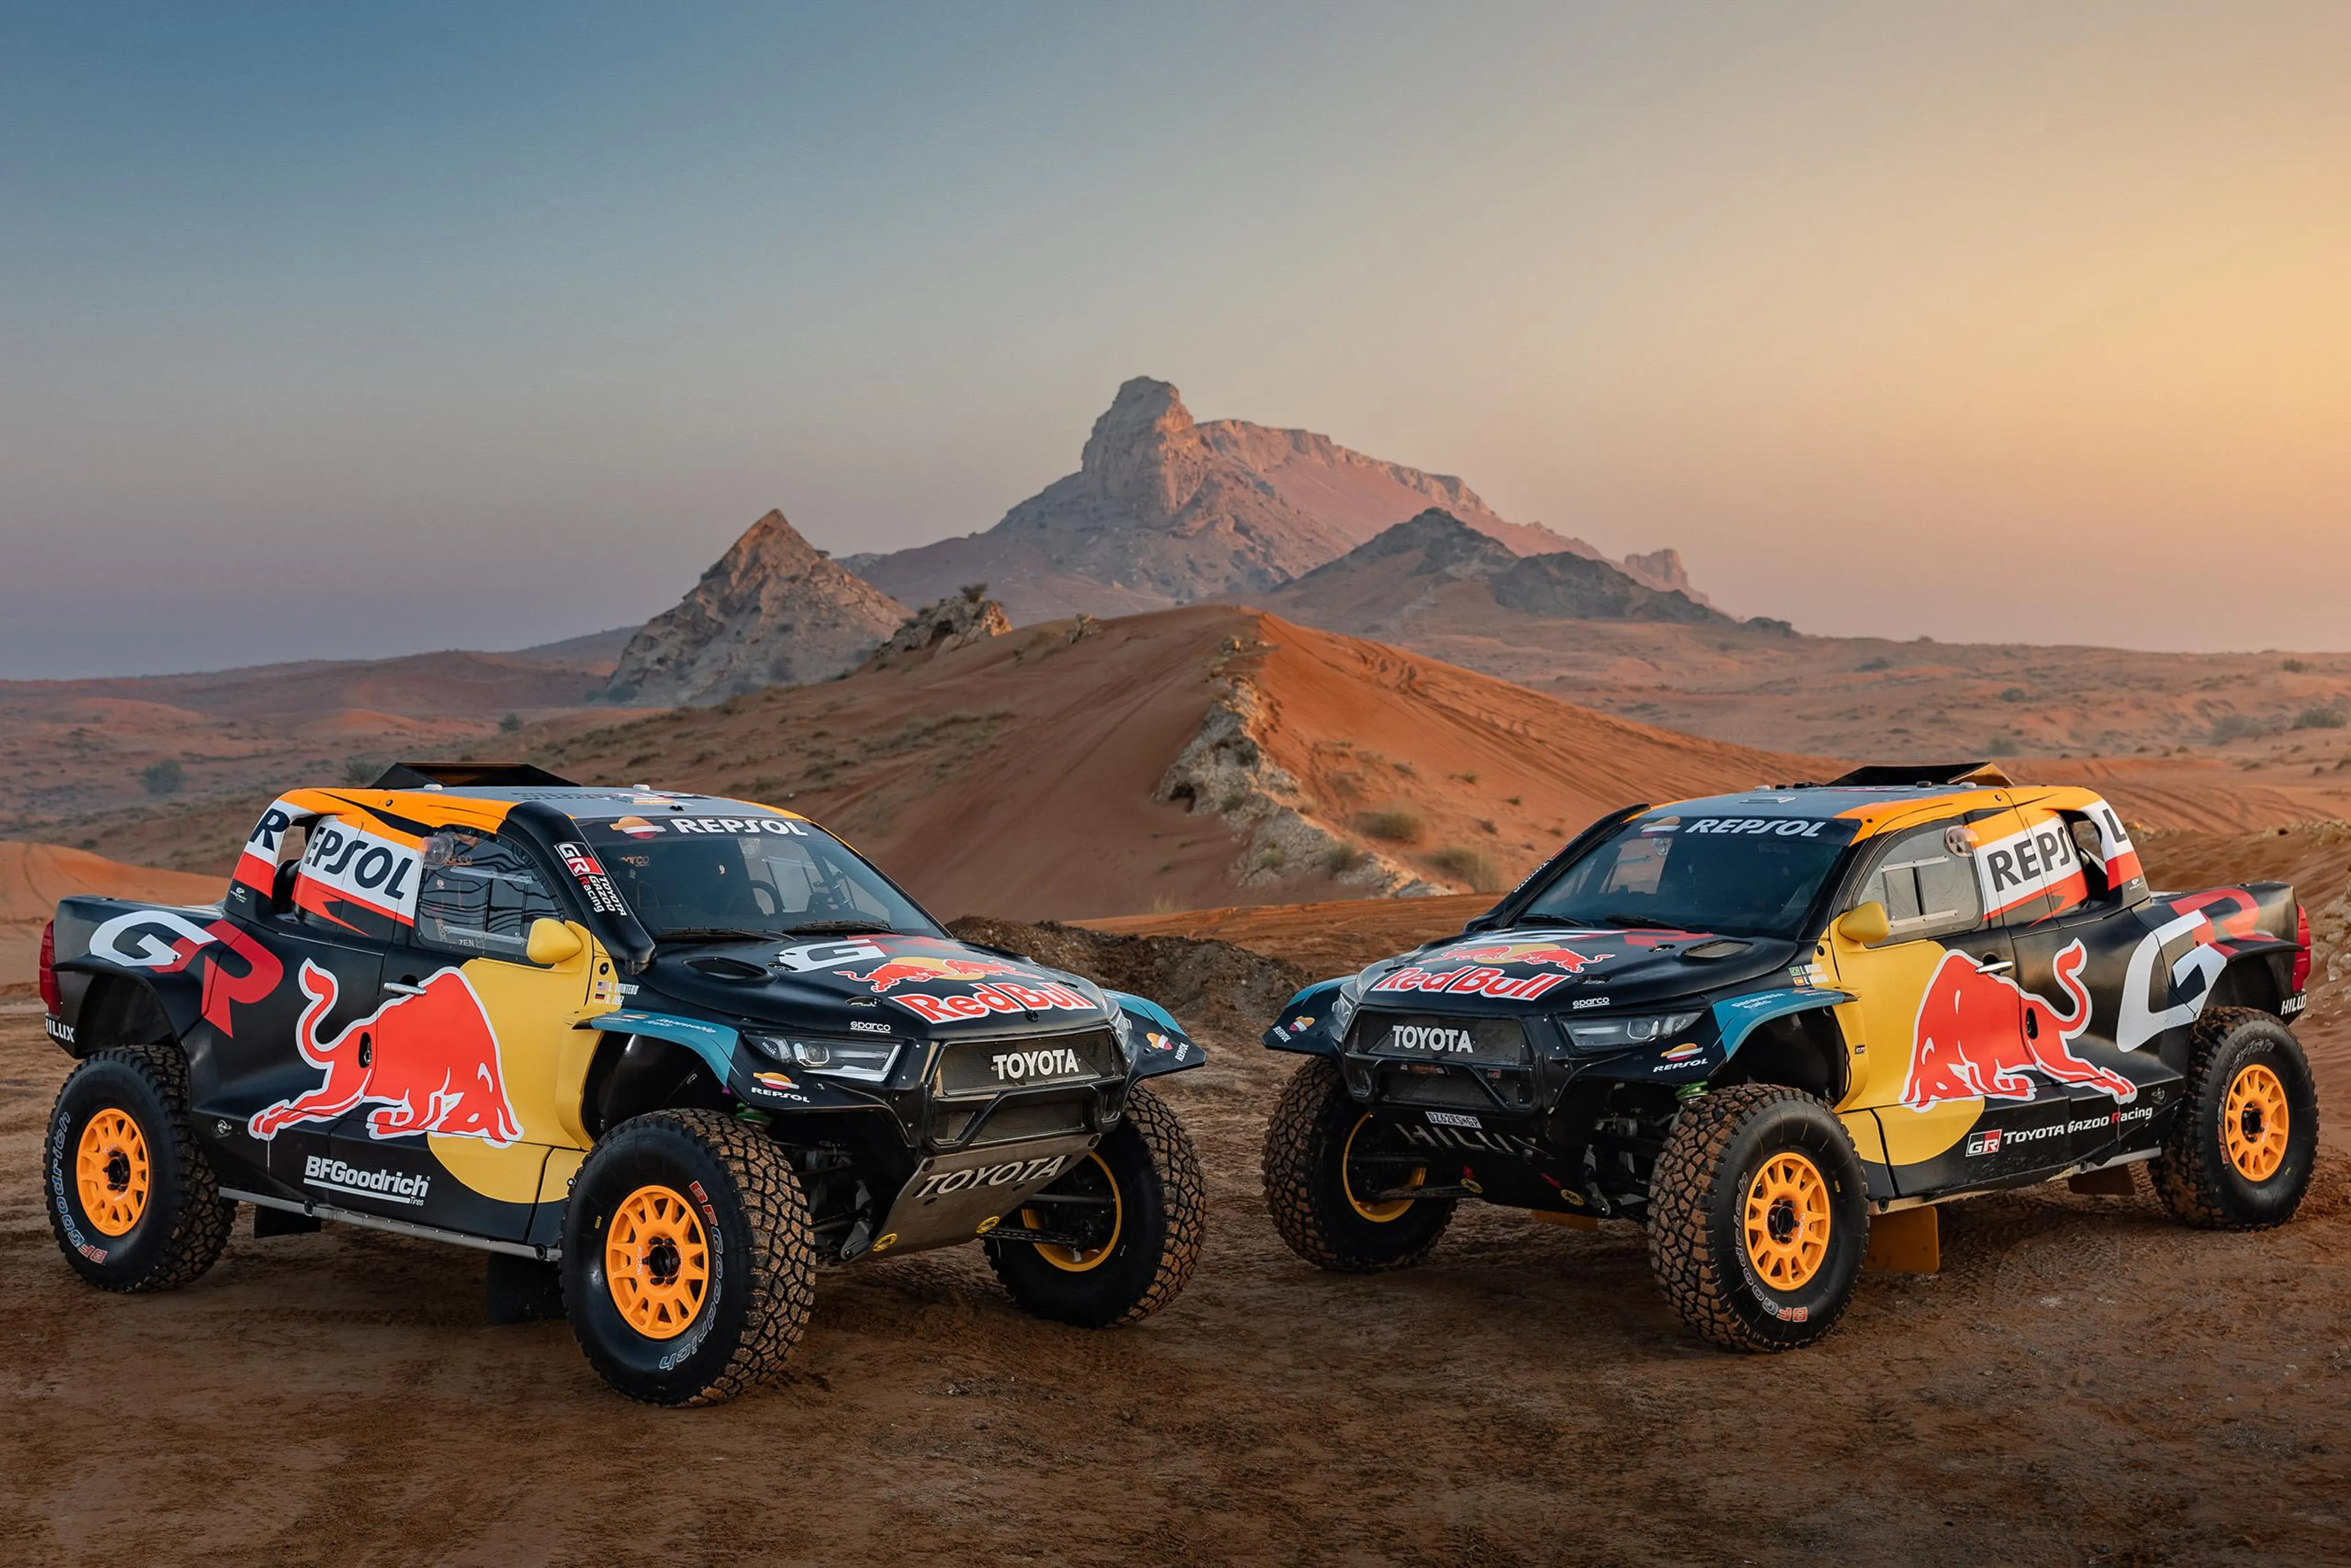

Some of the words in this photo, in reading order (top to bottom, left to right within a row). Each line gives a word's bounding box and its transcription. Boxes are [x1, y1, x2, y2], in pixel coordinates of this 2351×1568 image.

[670, 819, 809, 836] REPSOL
[1685, 819, 1826, 838] REPSOL
[558, 843, 591, 874] GR
[1987, 808, 2128, 893] REPSL
[579, 876, 606, 913] Racing
[588, 875, 616, 912] GAZOO
[599, 876, 628, 917] TOYOTA
[89, 910, 283, 1038] GR
[1573, 997, 1610, 1008] sparco
[850, 1021, 891, 1032] sparco
[1392, 1025, 1474, 1053] TOYOTA
[992, 1048, 1079, 1080] TOYOTA
[1653, 1058, 1708, 1073] REPSOL
[751, 1087, 811, 1103] REPSOL
[1968, 1139, 1999, 1154] GR
[2004, 1125, 2064, 1145] TOYOTA
[2068, 1116, 2109, 1133] GAZOO
[2111, 1107, 2153, 1124] Racing
[51, 1111, 108, 1264] BFGoodrich
[305, 1155, 429, 1197] BFGoodrich
[916, 1155, 1066, 1198] TOYOTA
[410, 1196, 424, 1206] Tires
[659, 1180, 724, 1371] BFGoodrich
